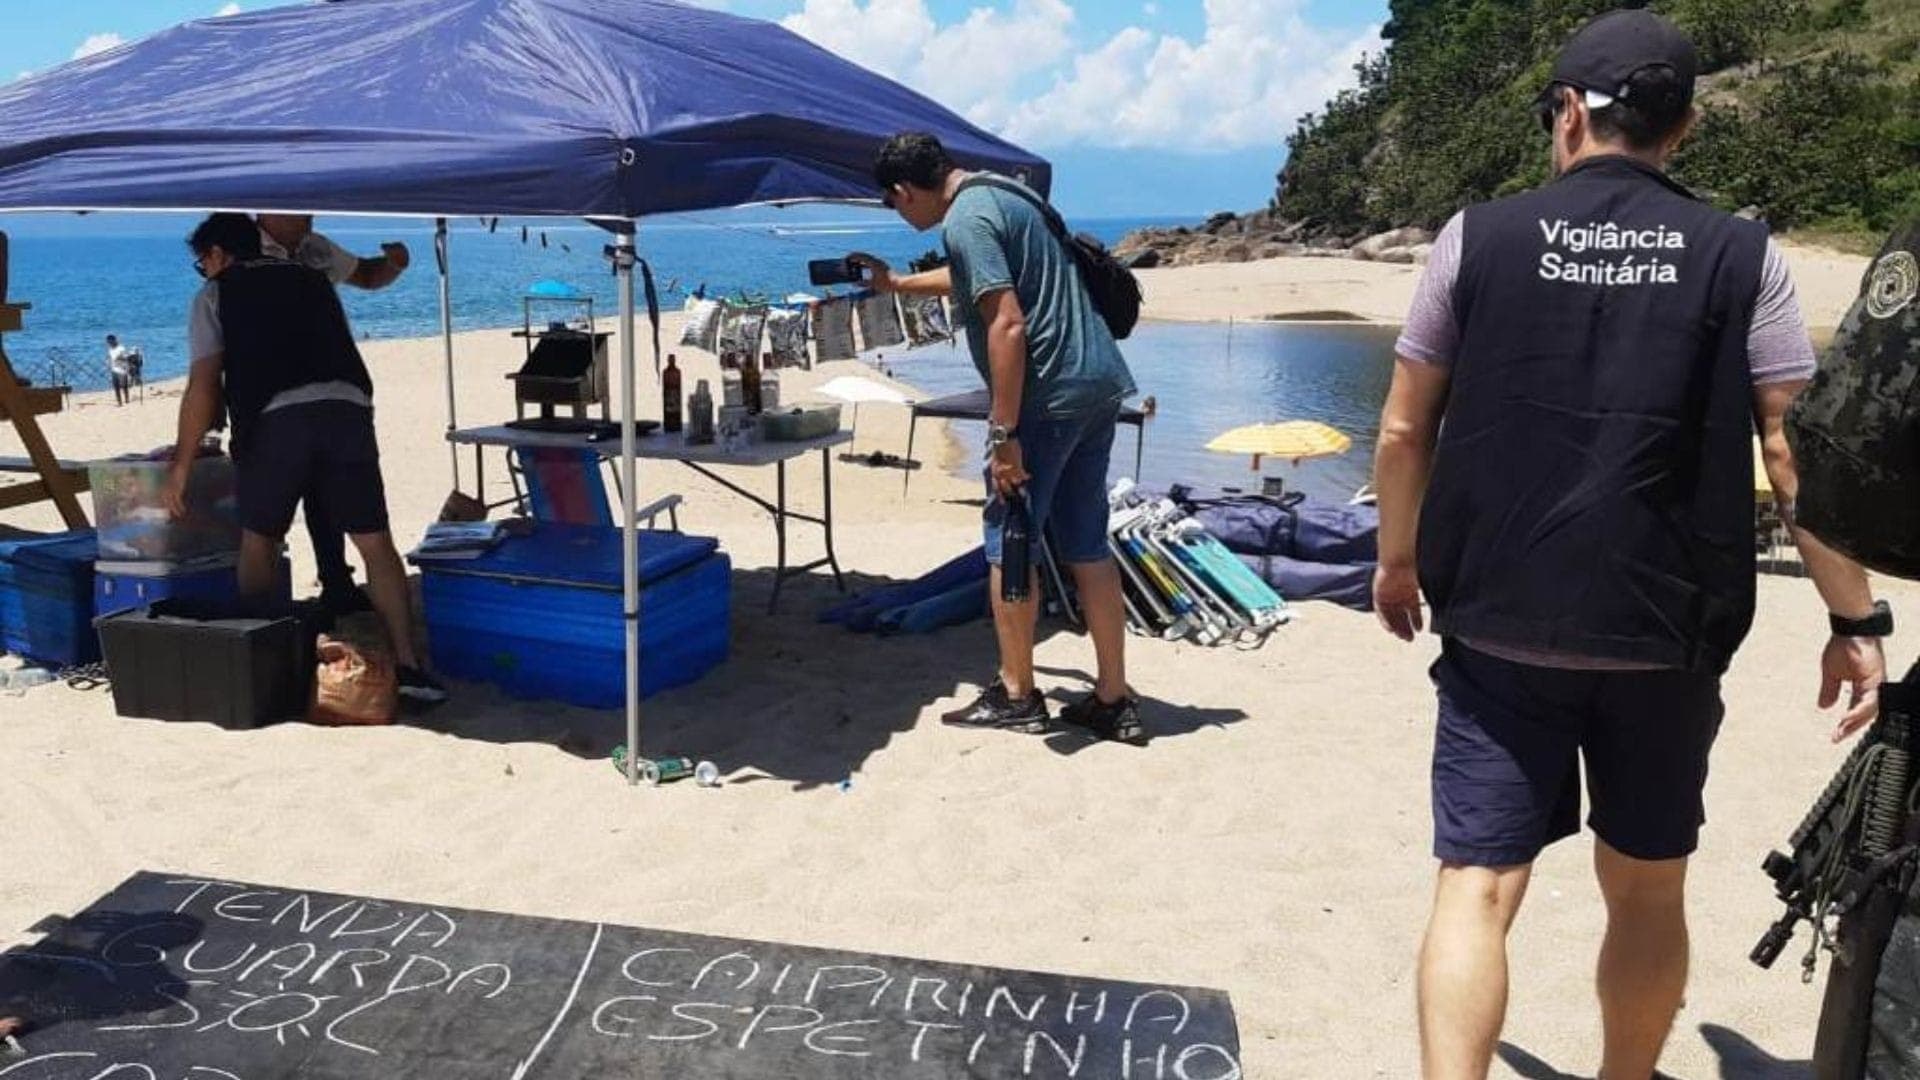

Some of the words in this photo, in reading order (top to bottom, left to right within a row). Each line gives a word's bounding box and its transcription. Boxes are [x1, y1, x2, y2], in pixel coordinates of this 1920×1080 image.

[1538, 218, 1687, 252] Vigilância
[1538, 252, 1679, 286] Sanitária
[165, 879, 457, 948] TENDA
[102, 921, 512, 999] GUARDA
[621, 947, 1191, 1034] CAIPIRINHA
[591, 995, 1242, 1080] ESPETINHO
